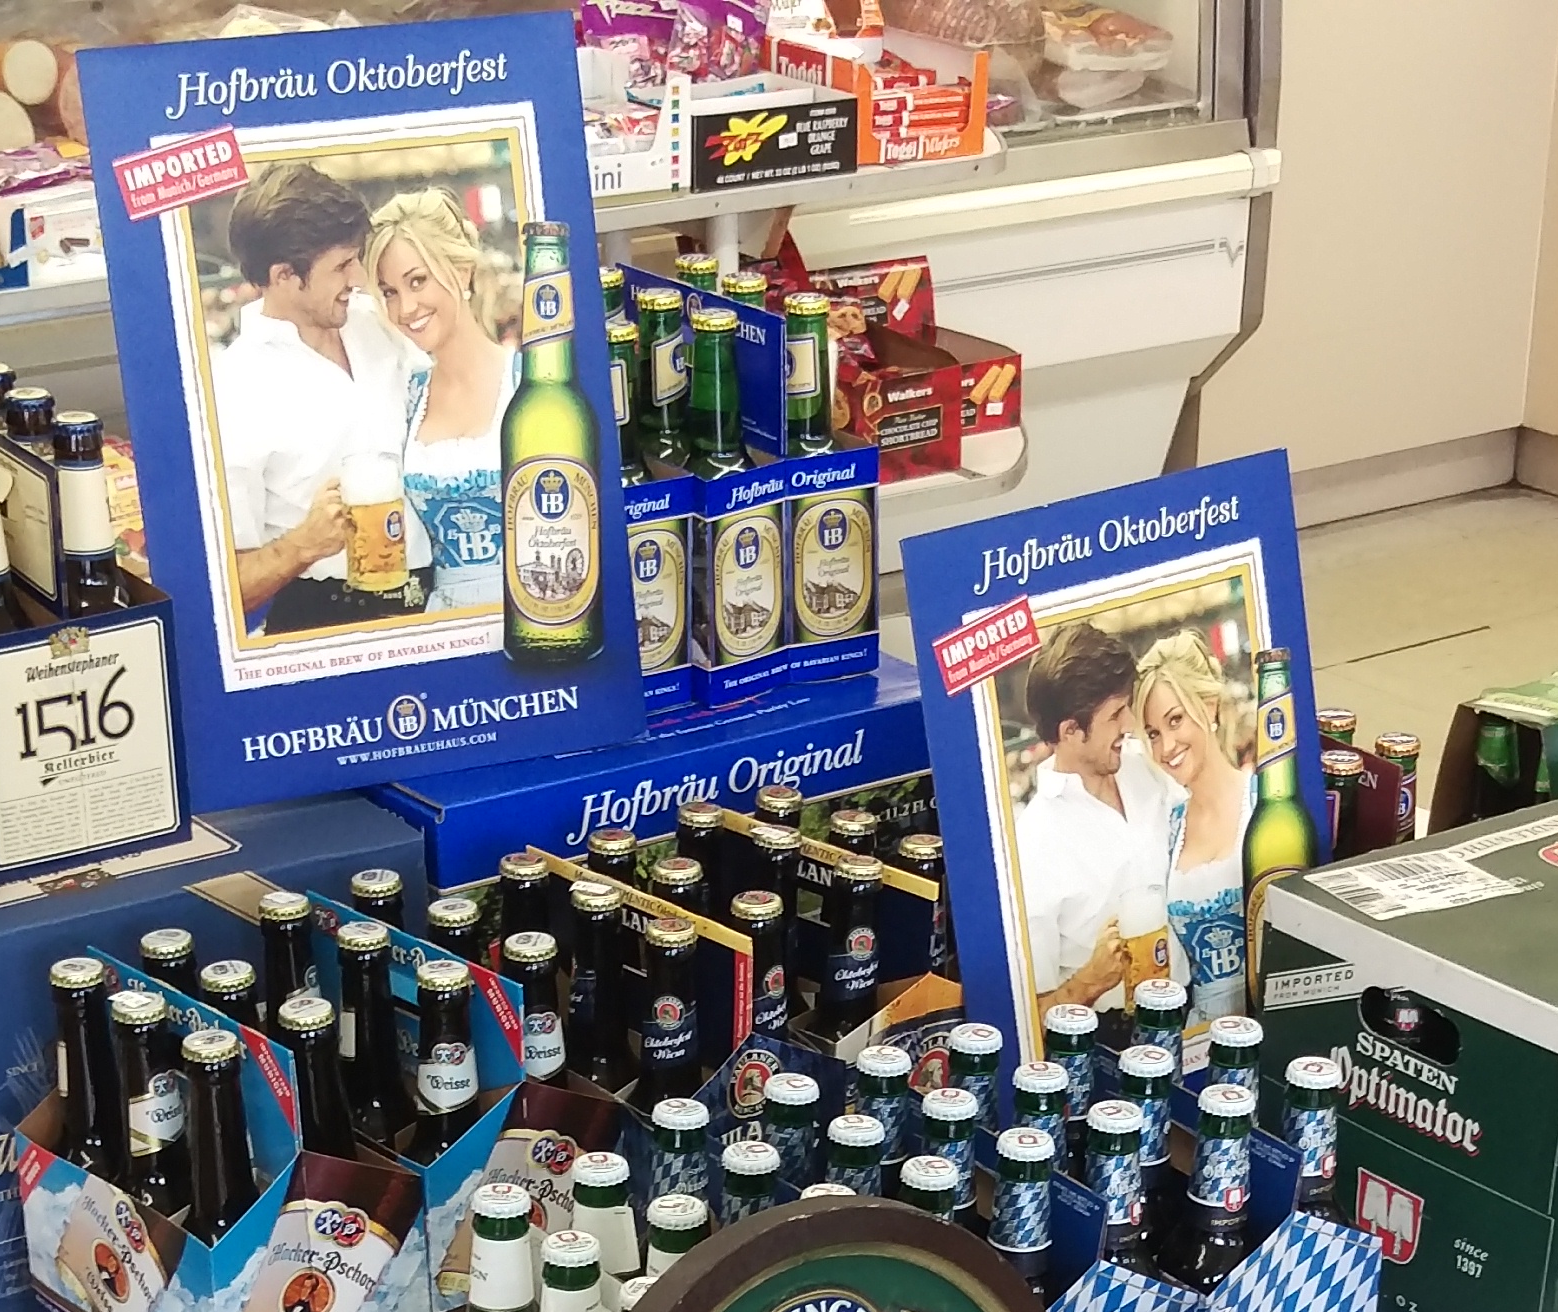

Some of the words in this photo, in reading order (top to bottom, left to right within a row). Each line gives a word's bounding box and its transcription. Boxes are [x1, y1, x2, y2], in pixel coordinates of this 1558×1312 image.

[165, 68, 317, 120] Hofbräu
[326, 49, 507, 96] Oktoberfest
[807, 131, 836, 143] ORANGE
[810, 143, 832, 155] GRAPE
[123, 142, 233, 190] IMPORTED
[887, 387, 933, 403] Walkers
[880, 428, 938, 447] SHORTBREAD
[539, 492, 566, 515] HB
[726, 479, 784, 509] Hofbräu
[791, 466, 856, 488] Original
[974, 539, 1091, 595] Hofbräu
[1098, 495, 1240, 551] Oktoberfest
[235, 666, 263, 681] THE
[265, 659, 326, 678] ORIGINAL
[330, 653, 363, 669] BREW
[368, 649, 384, 662] OF
[387, 640, 446, 659] BAVARIAN
[448, 631, 491, 650] KINGS!
[941, 608, 1028, 668] IMPORTED
[25, 651, 119, 683] Weihenstephaner
[15, 666, 134, 760] 1516
[242, 715, 384, 763] HOFBRÄU
[432, 686, 579, 732] MÜNCHEN
[43, 748, 116, 773] Kellerbier
[336, 731, 497, 767] WWW.HOFBRAEUHAUS.COM
[567, 771, 719, 845] Hofbräu
[728, 729, 864, 793] Original
[1273, 989, 1299, 999] FROM
[1303, 985, 1341, 996] MUNICH
[1274, 968, 1355, 990] IMPORTED
[1356, 1031, 1459, 1095] SPATEN
[1329, 1046, 1482, 1156] Optimator
[1453, 1237, 1490, 1262] since
[1455, 1254, 1483, 1278] 1397
